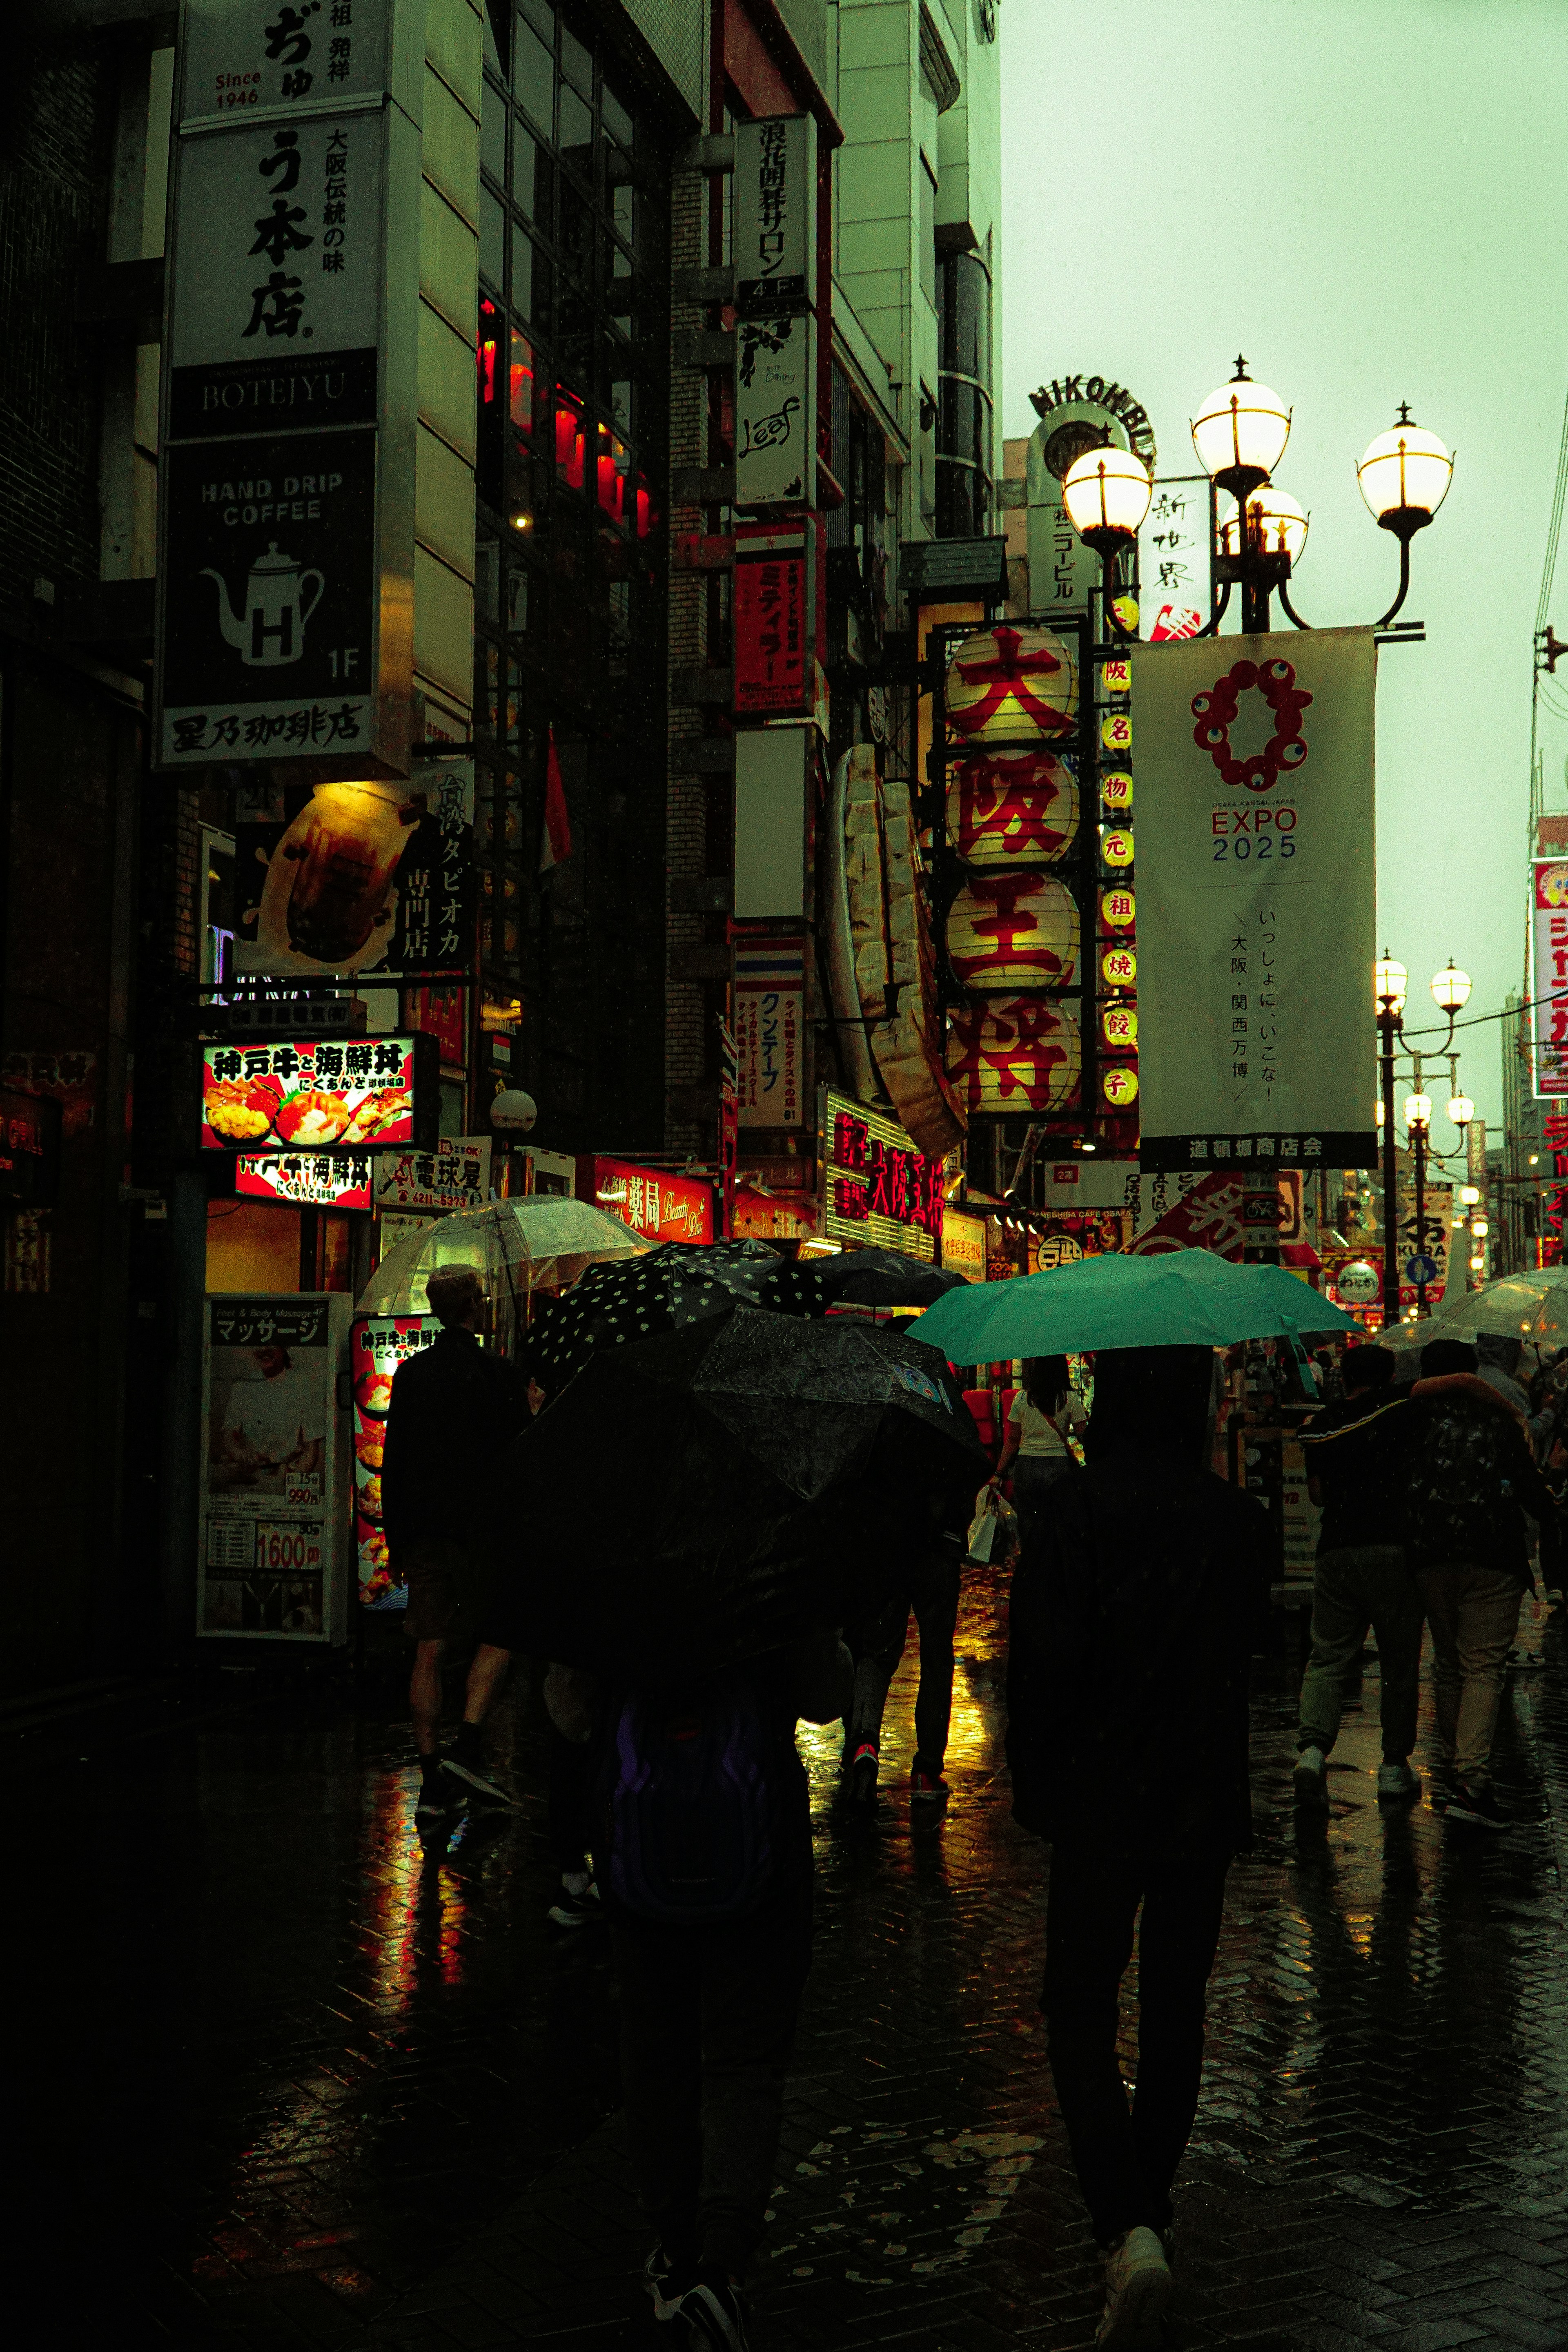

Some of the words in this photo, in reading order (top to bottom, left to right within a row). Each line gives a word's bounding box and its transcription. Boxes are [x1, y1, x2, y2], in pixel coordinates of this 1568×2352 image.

[215, 71, 261, 90] Since
[216, 89, 259, 109] 1946
[322, 129, 349, 274] 大阪伝統の味
[758, 123, 787, 276] 浪花囲碁サロン
[202, 372, 347, 411] BOTEJYU
[738, 396, 801, 459] Leaf
[201, 478, 272, 504] HAND
[283, 472, 344, 496] DRIP
[223, 499, 322, 527] COFFEE
[1151, 493, 1197, 591] 新世界
[251, 605, 293, 659] H
[328, 647, 359, 679] 1F
[172, 702, 364, 753] 星乃珈琲店
[1212, 807, 1297, 835] EXPO
[437, 774, 466, 958] 台湾タピオカ
[1213, 835, 1297, 862] 2025
[944, 626, 1081, 1112] 大阪王将
[402, 869, 431, 959] 専門店
[212, 1043, 404, 1081] 神戸牛と海鮮丼
[299, 1077, 366, 1092] にくあんど
[1189, 1135, 1323, 1159] 道頓堀商店会
[416, 1155, 481, 1191] 電球屋
[628, 1175, 660, 1234] 薬局
[661, 1190, 690, 1232] Beauty
[1078, 1210, 1102, 1219] CAFE
[217, 1318, 319, 1344] マッサージ
[257, 1530, 321, 1569] 1600円
